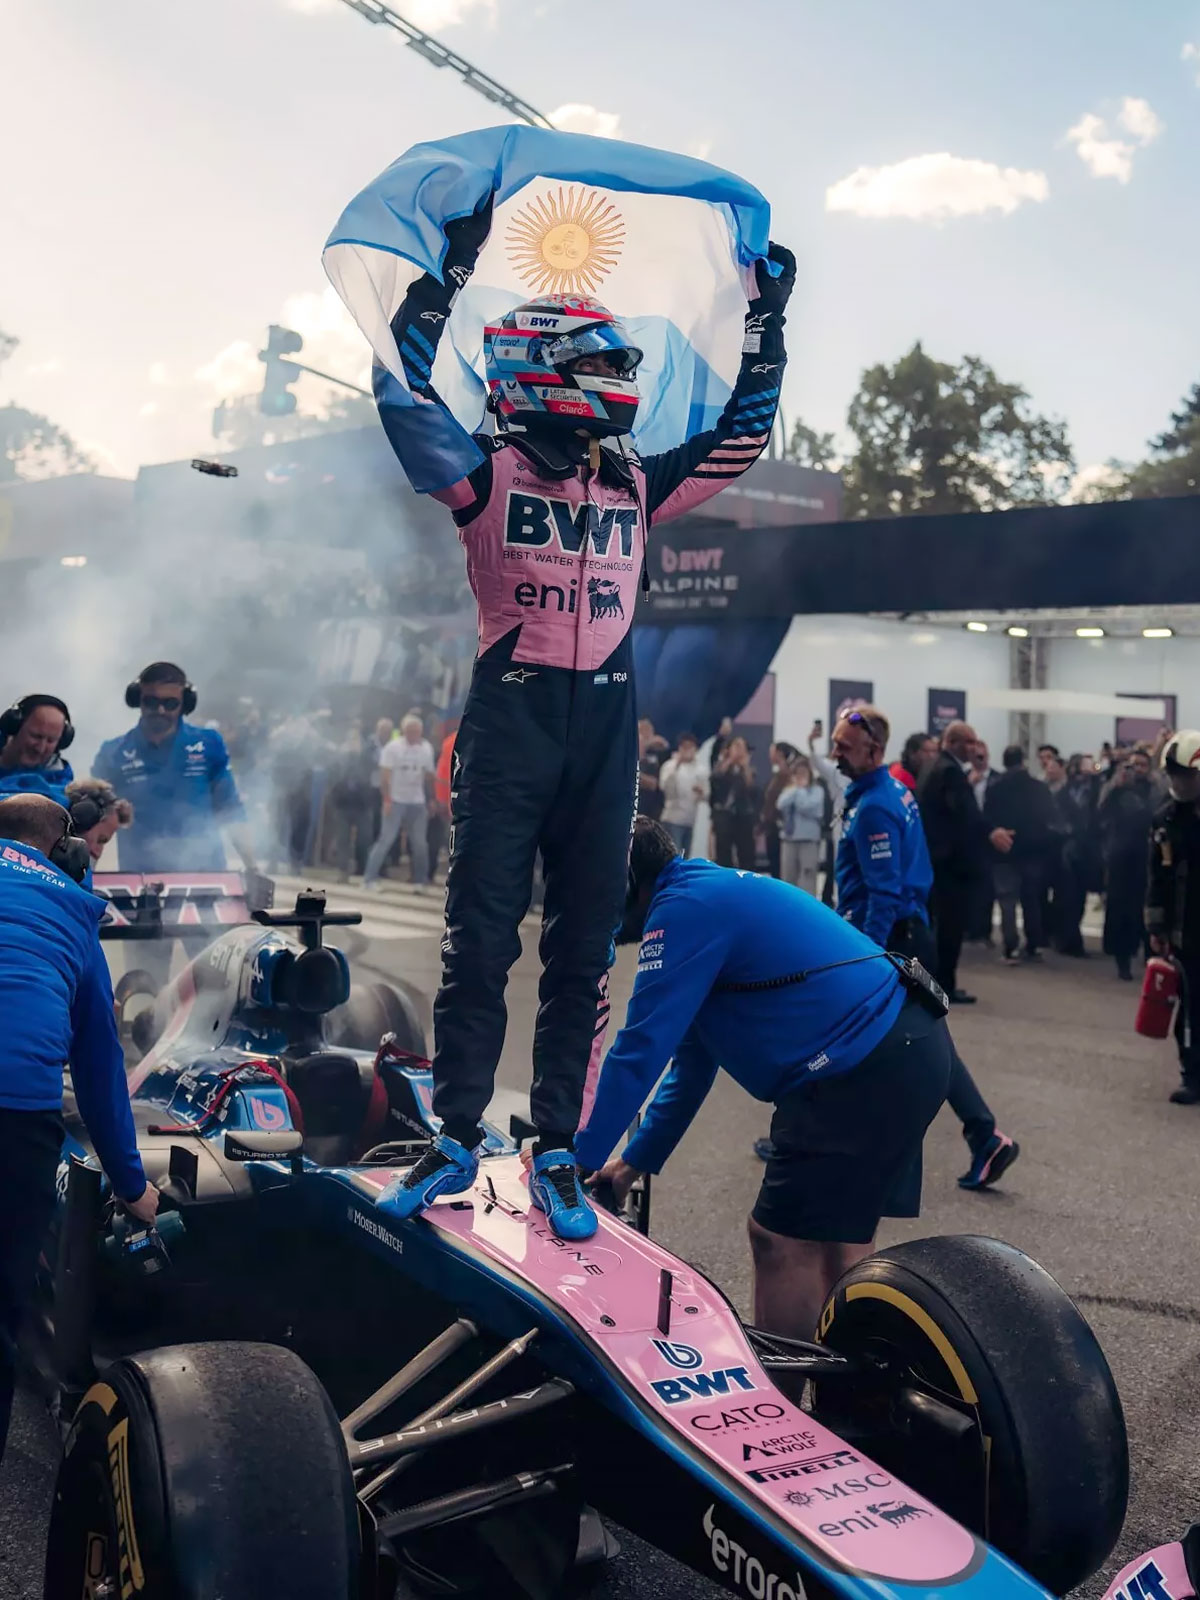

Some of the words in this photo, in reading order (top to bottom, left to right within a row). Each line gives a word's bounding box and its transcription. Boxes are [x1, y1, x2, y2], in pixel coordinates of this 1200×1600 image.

[530, 316, 560, 328] BWT
[559, 403, 584, 415] Claro
[504, 489, 640, 560] BWT
[503, 550, 531, 561] BEST
[534, 553, 574, 567] WATER
[514, 578, 578, 614] eni
[649, 575, 739, 593] ALPINE
[12, 865, 32, 875] ONE
[41, 873, 66, 889] TEAM
[648, 1365, 758, 1407] BWT
[690, 1403, 786, 1431] CATO
[761, 1430, 816, 1449] ARCTIC
[775, 1438, 819, 1455] WOLF
[744, 1450, 861, 1484] PIRELLI
[811, 1472, 892, 1501] MSC
[817, 1509, 879, 1538] eni
